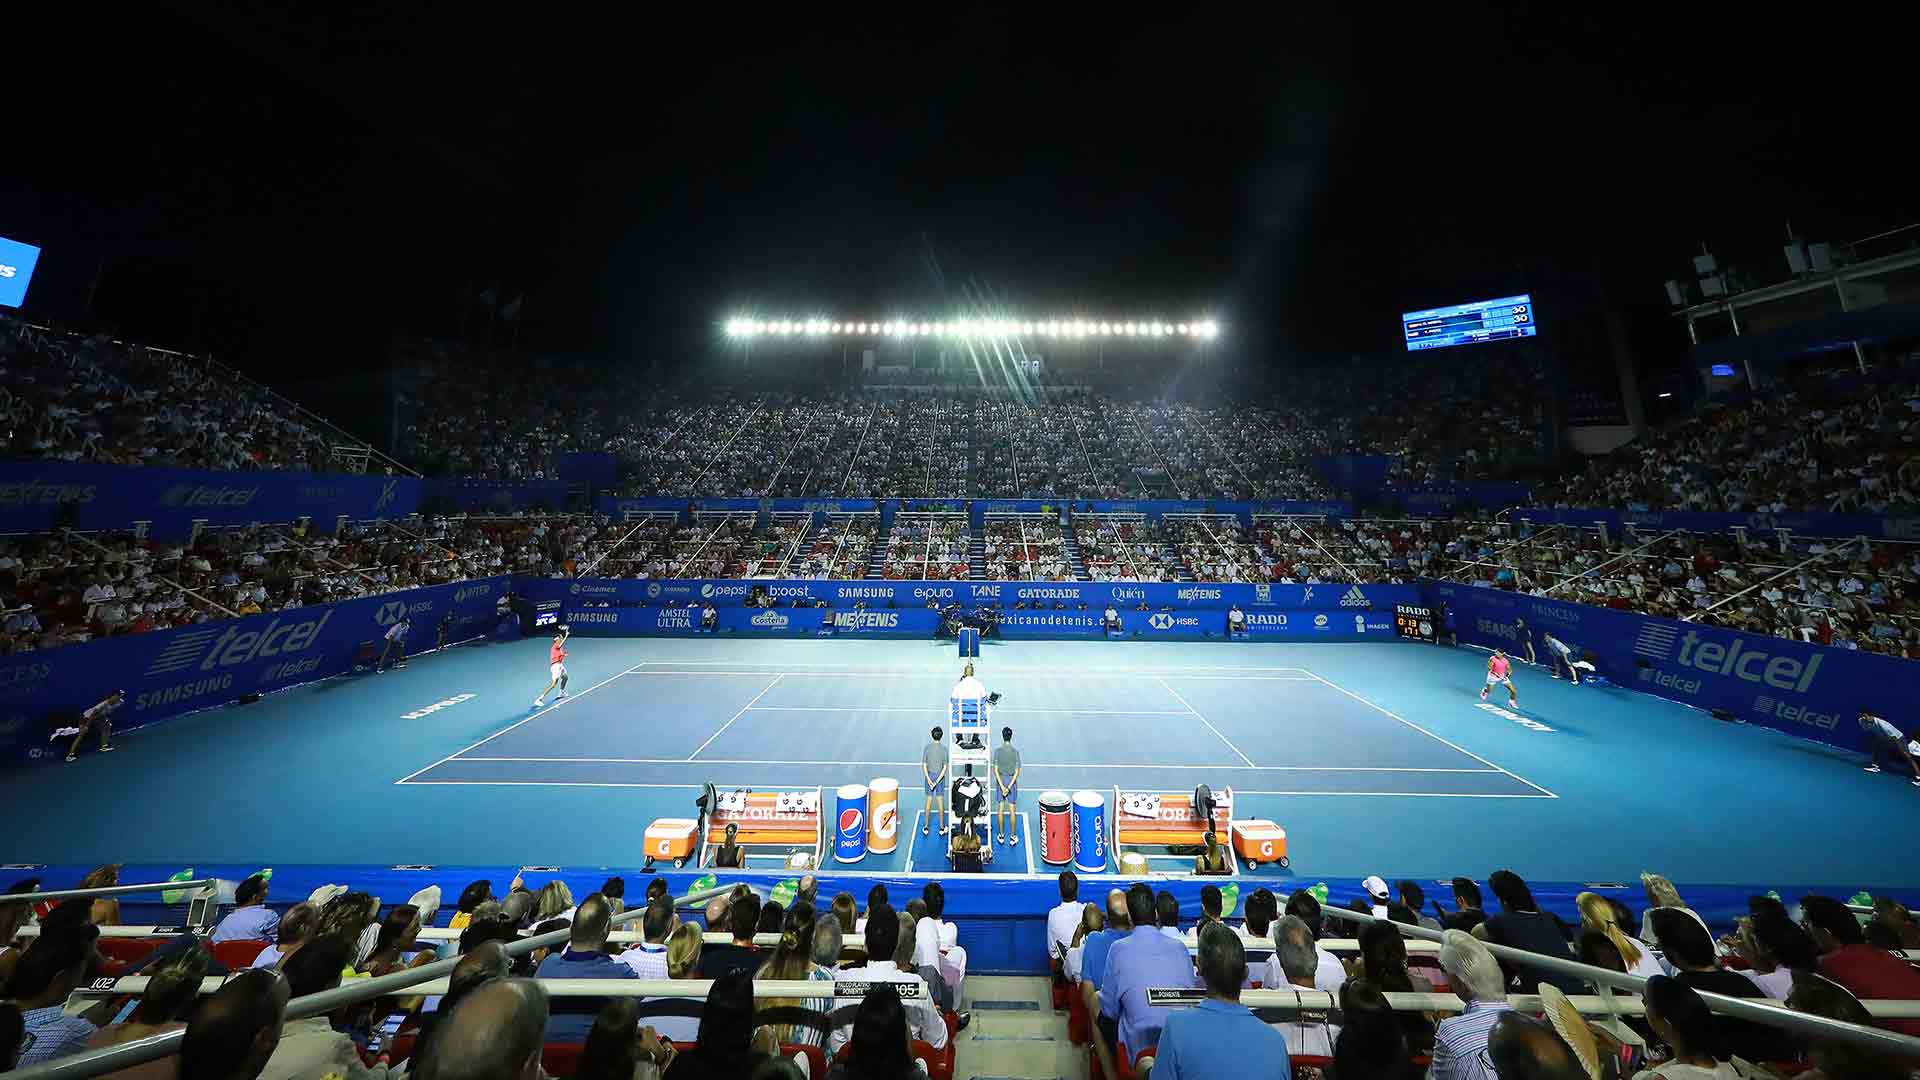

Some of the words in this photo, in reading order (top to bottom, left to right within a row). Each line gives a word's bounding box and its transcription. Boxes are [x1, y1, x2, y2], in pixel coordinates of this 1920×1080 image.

[1512, 305, 1526, 314] 30
[1514, 314, 1528, 322] 30
[715, 585, 747, 597] pepsi
[838, 588, 894, 598] SAMSUNG
[971, 585, 1001, 597] TANE
[1018, 588, 1080, 599] GATORADE
[1112, 586, 1145, 601] Quién
[1178, 587, 1221, 600] MEXTENIS
[1340, 599, 1370, 607] adidas
[658, 608, 691, 618] AMSTEL
[1397, 604, 1430, 616] RADO
[567, 612, 618, 623] SAMSUNG
[657, 618, 692, 628] ULTRA
[834, 609, 898, 632] MEXTENIS
[1176, 617, 1199, 625] HSBC
[1246, 614, 1287, 624] RADO
[200, 607, 336, 671] telcel
[1677, 630, 1825, 693] telcel
[1655, 668, 1702, 694] telcel
[135, 672, 232, 712] SAMSUNG
[1775, 701, 1840, 731] telcel
[658, 839, 671, 855] G
[841, 838, 860, 848] pepsi
[1261, 840, 1273, 856] G
[91, 977, 115, 989] 102
[895, 983, 915, 996] 105
